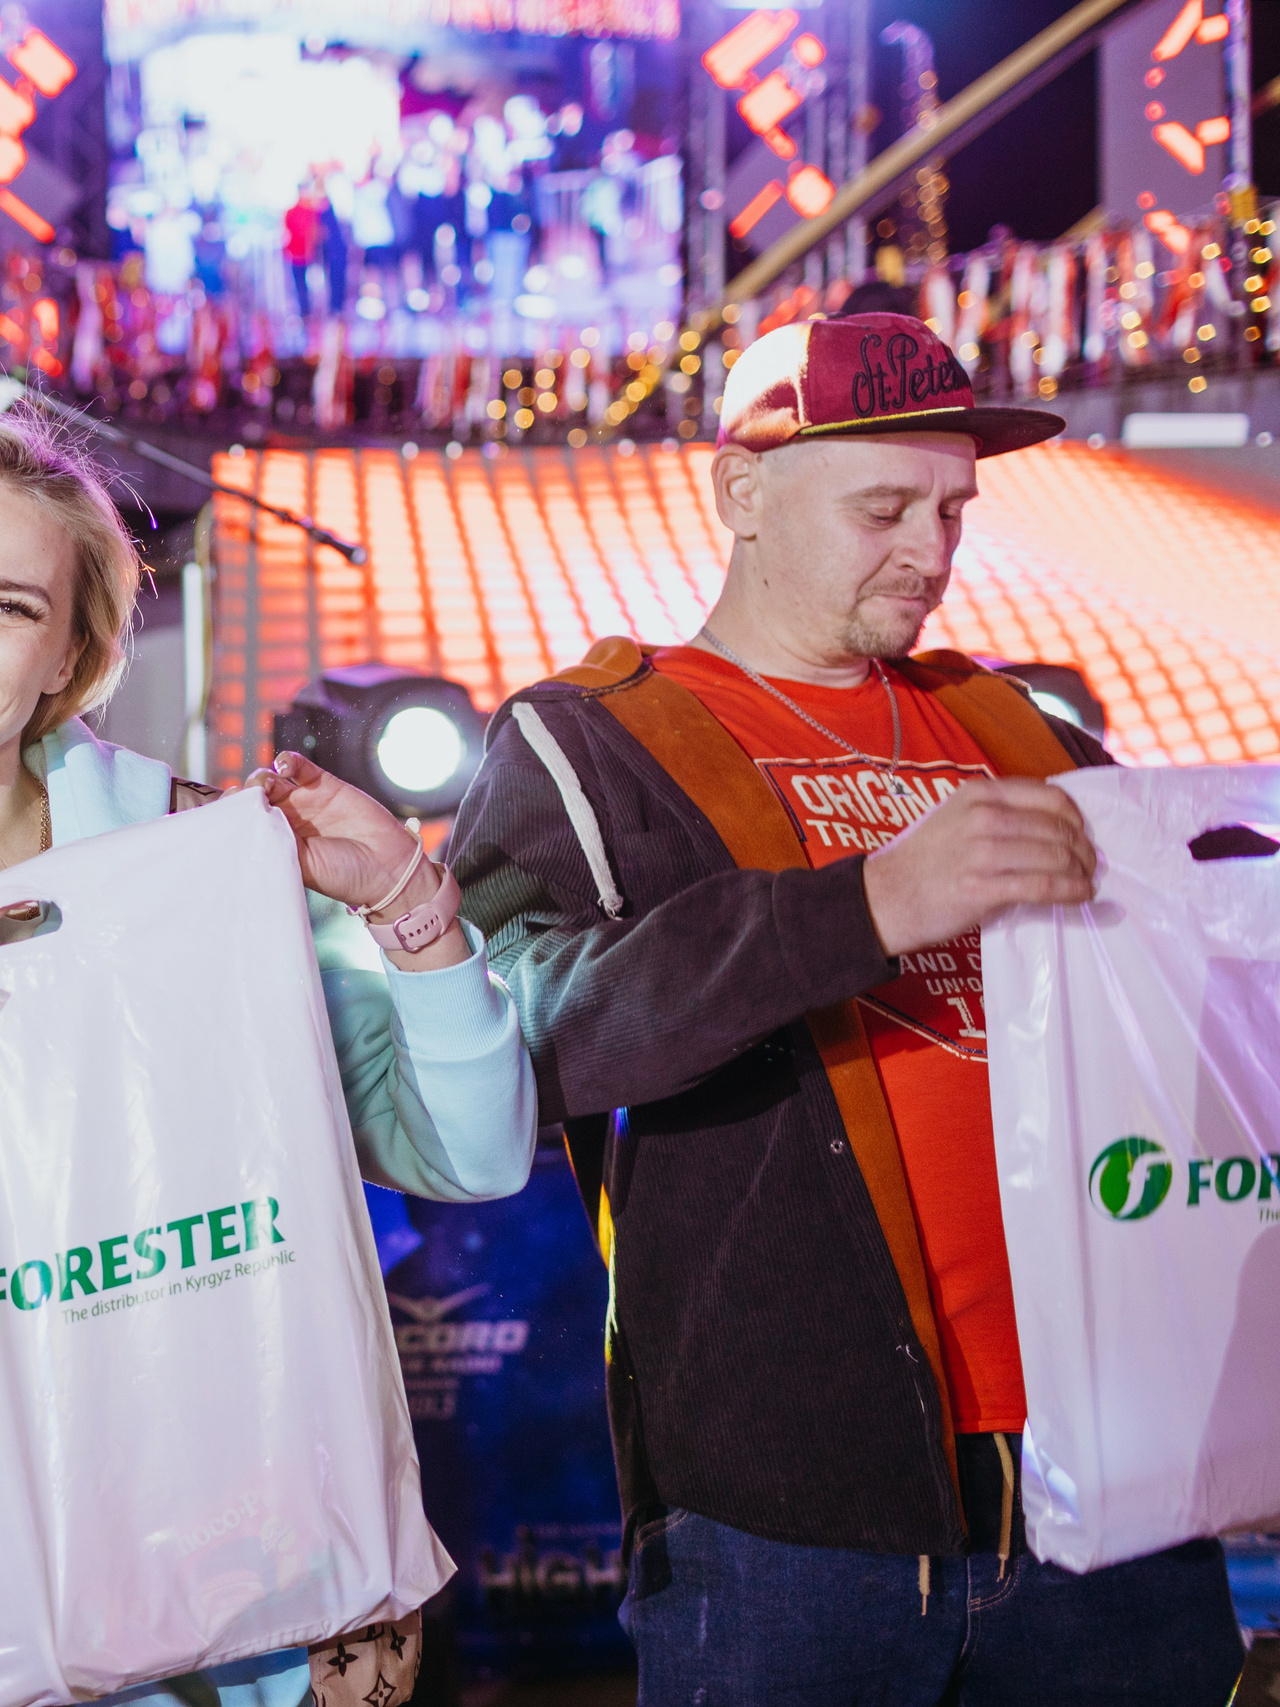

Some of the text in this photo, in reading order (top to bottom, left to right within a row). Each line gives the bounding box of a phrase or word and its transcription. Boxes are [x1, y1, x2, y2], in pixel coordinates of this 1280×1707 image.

[791, 770, 967, 828] ORIGINA
[899, 952, 957, 975] AND
[62, 1249, 297, 1326] The distributor in Kyrgyz Republic
